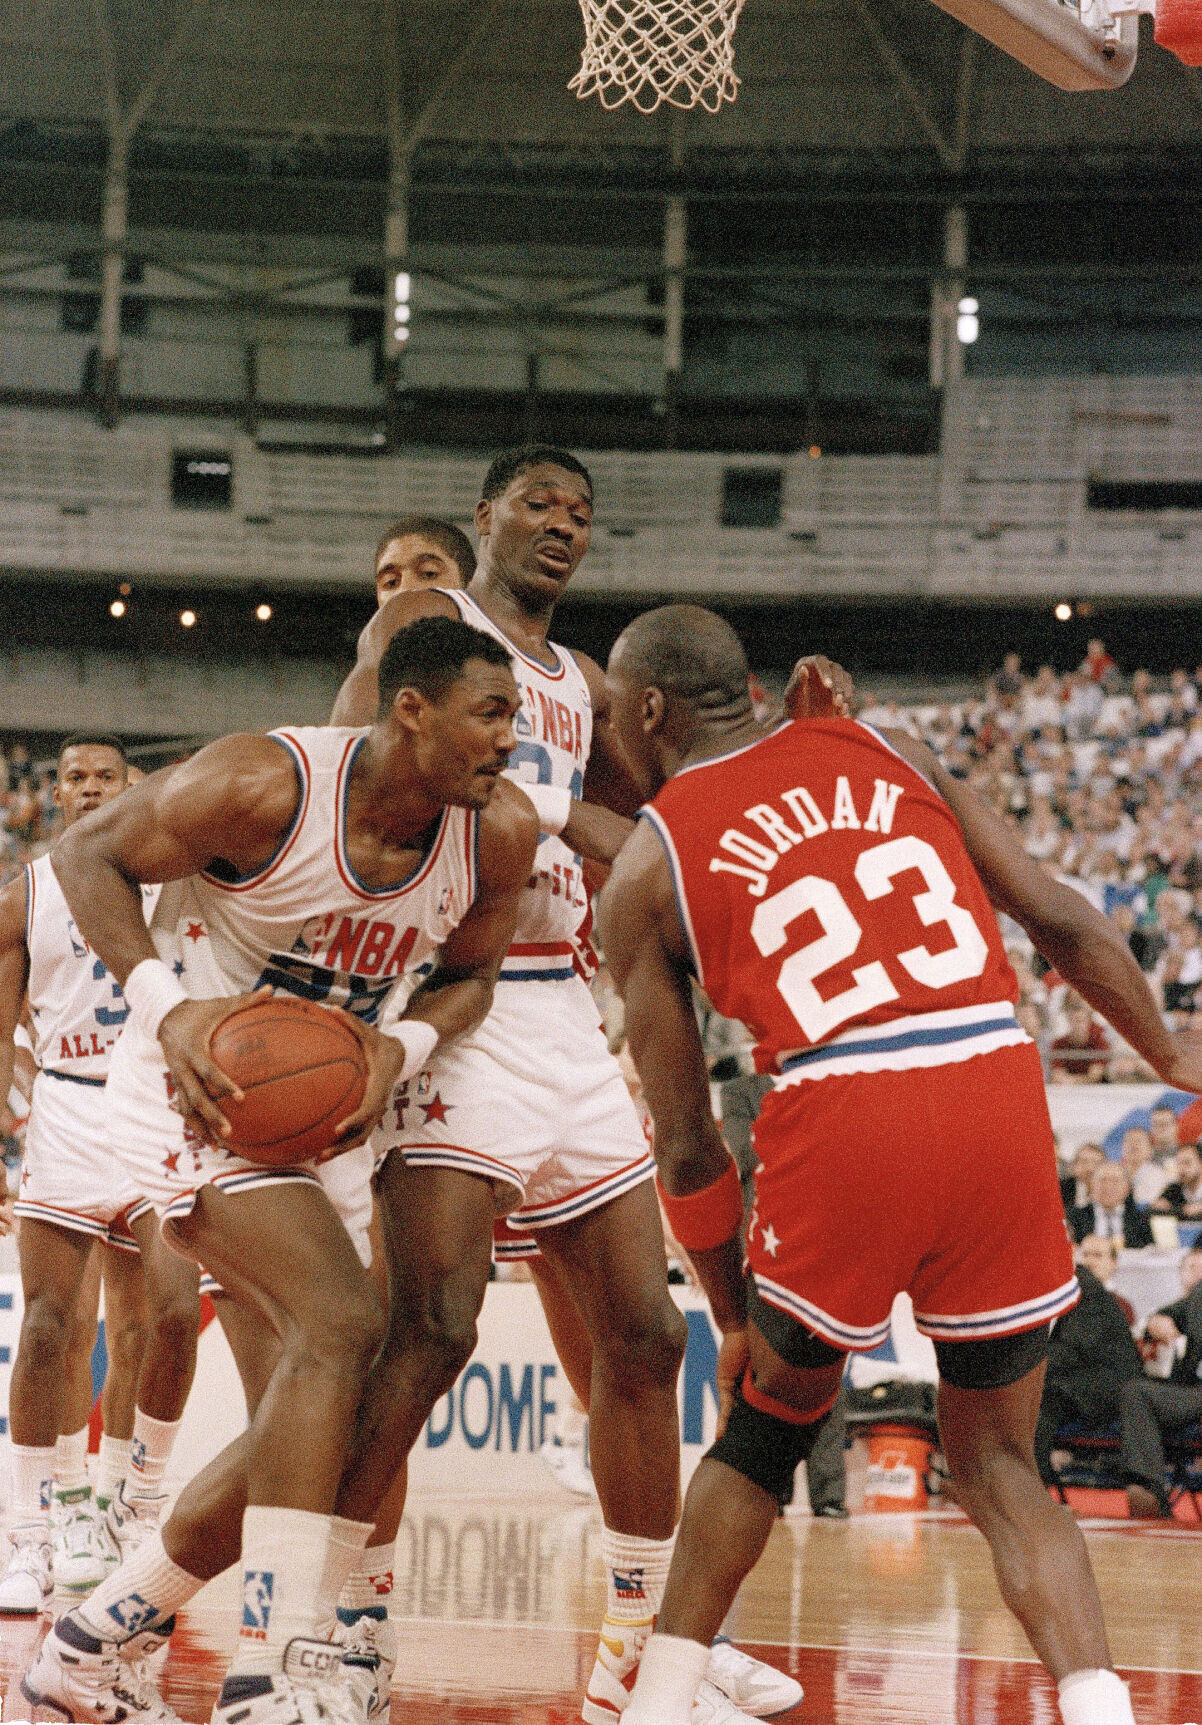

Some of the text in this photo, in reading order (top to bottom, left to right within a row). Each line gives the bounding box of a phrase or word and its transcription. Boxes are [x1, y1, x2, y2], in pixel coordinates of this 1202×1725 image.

[709, 776, 905, 897] JORDAN
[325, 907, 419, 976] NBA
[750, 835, 989, 1043] 23
